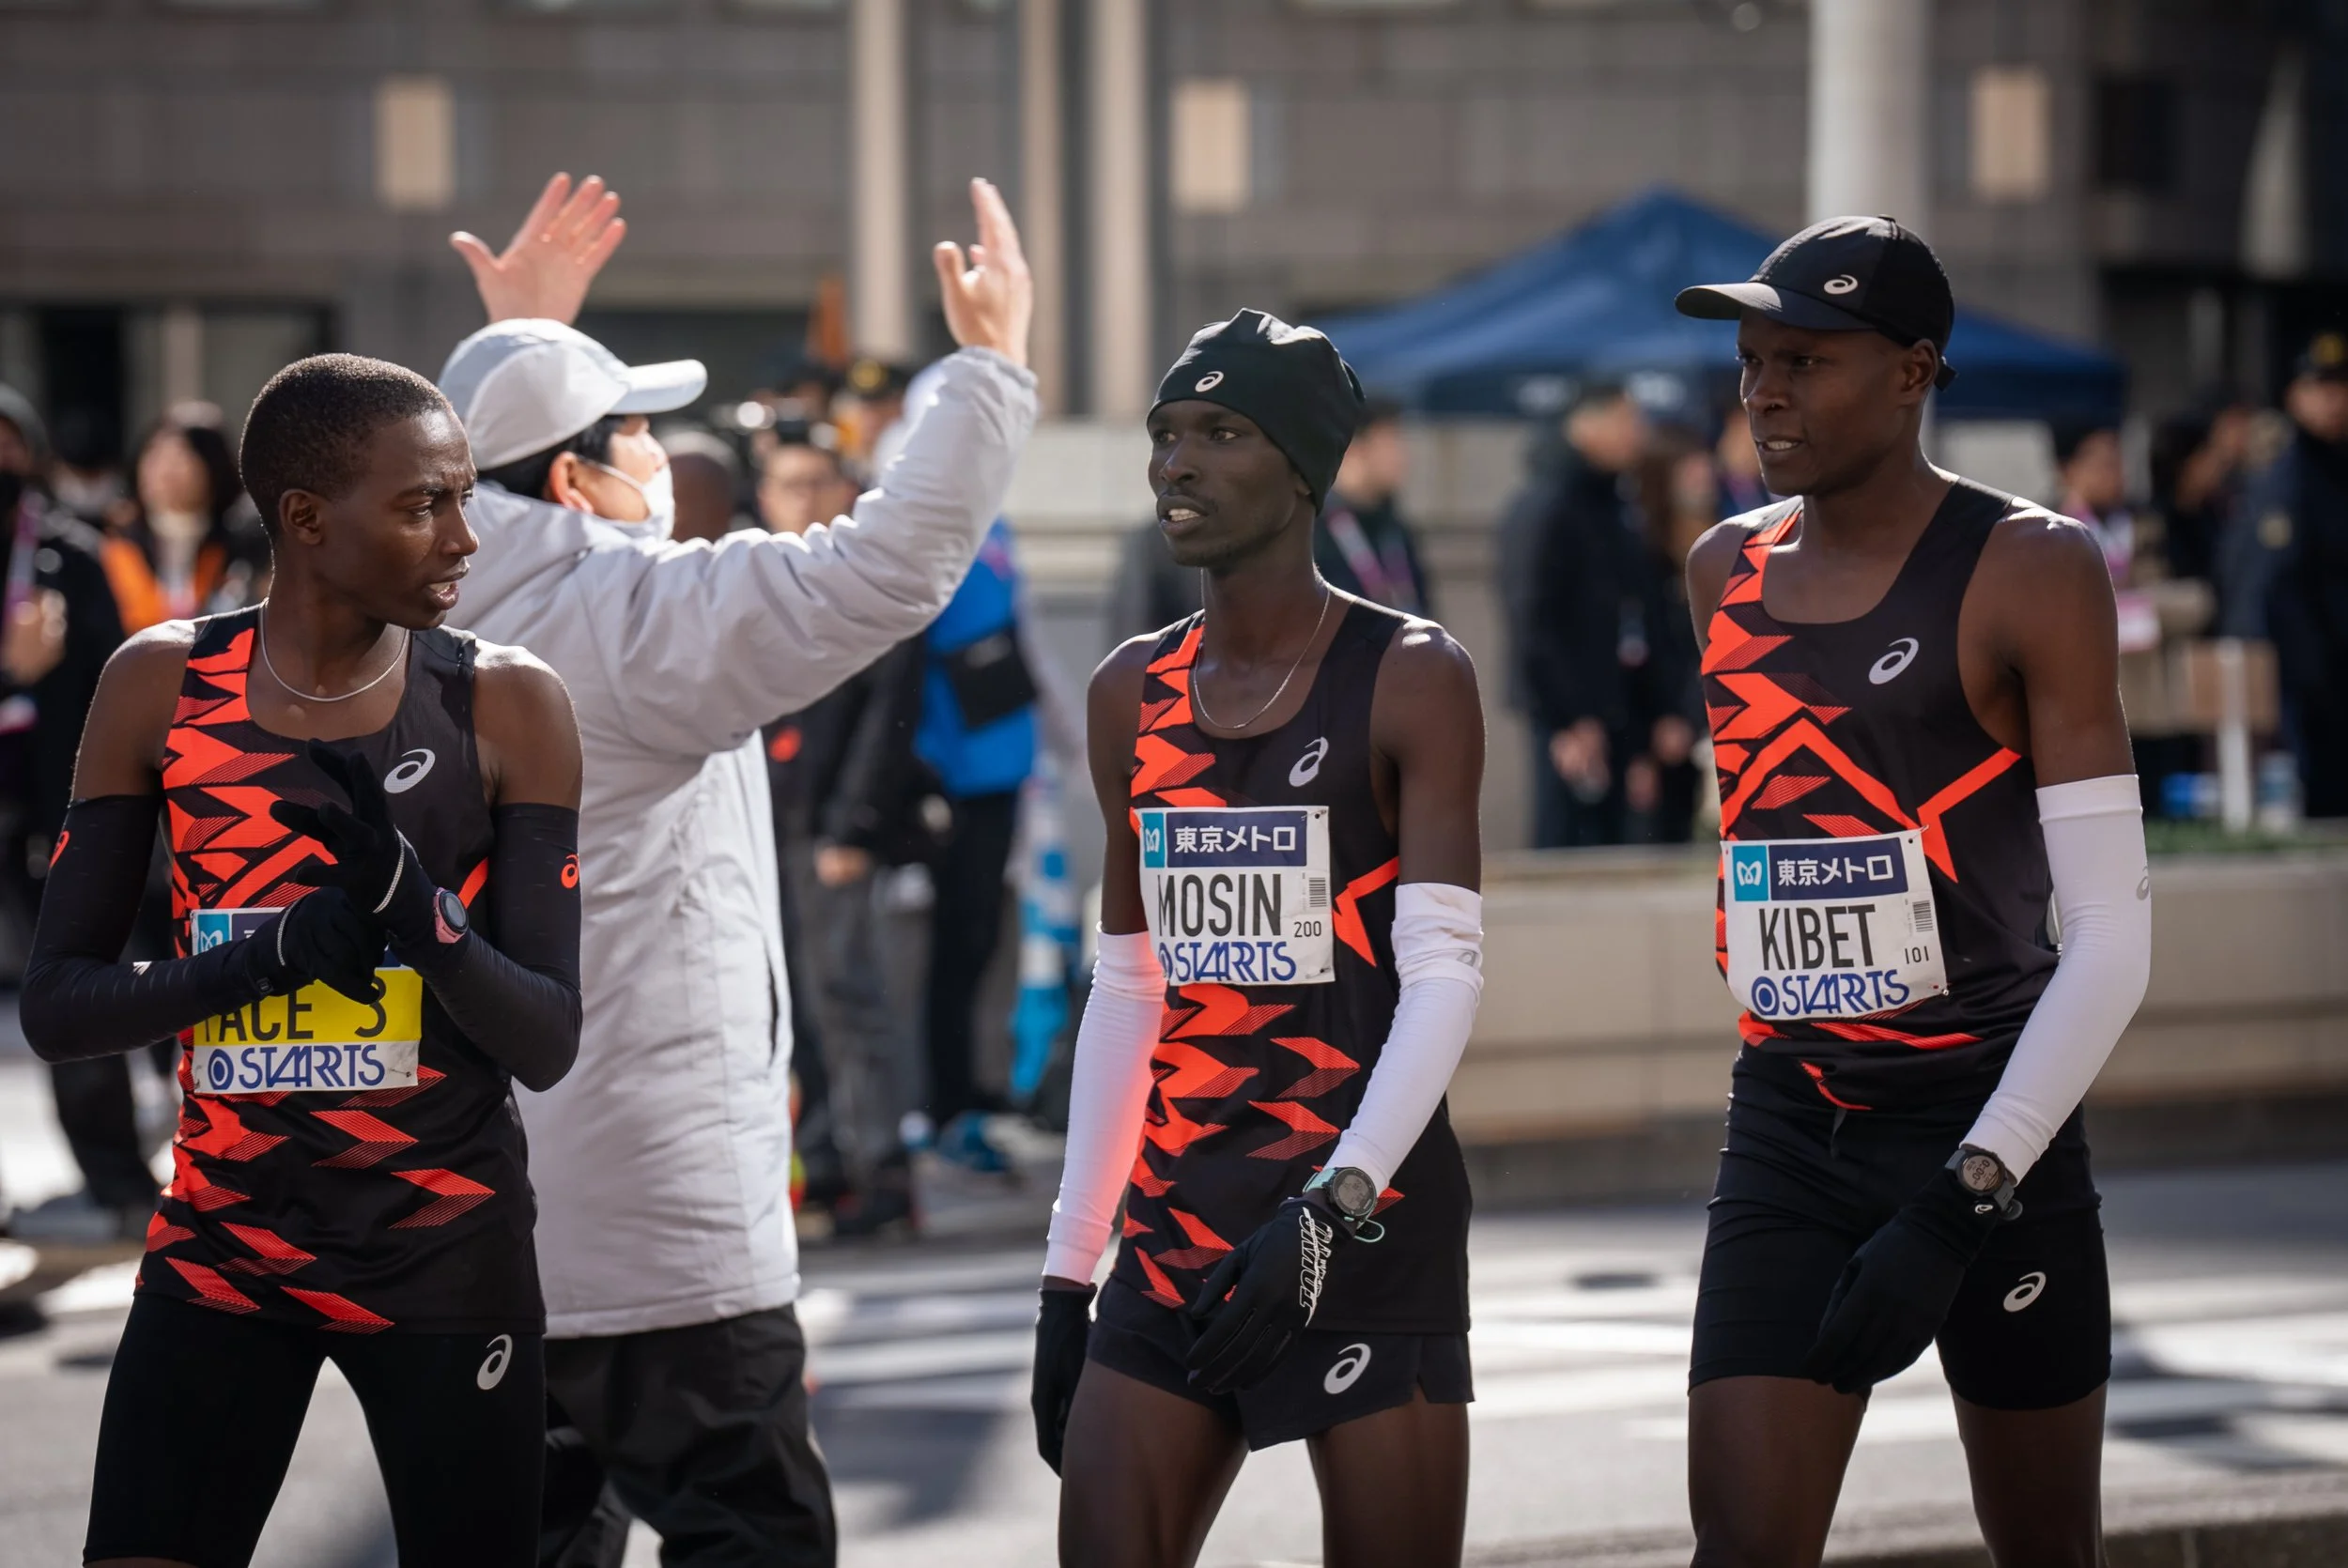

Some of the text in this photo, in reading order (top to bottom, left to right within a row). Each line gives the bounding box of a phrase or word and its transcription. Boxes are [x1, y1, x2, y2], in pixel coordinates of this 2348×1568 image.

[1174, 825, 1297, 853] 東京メトロ
[1776, 854, 1894, 887] 東京メトロ
[1157, 873, 1282, 937] MOSIN
[1293, 920, 1322, 938] 200
[1758, 903, 1877, 971] KIBET
[1174, 941, 1297, 982] STARTS
[1904, 945, 1930, 965] 101
[1782, 969, 1910, 1016] STARTS
[204, 990, 315, 1042] ACE
[238, 1044, 386, 1089] STARTS
